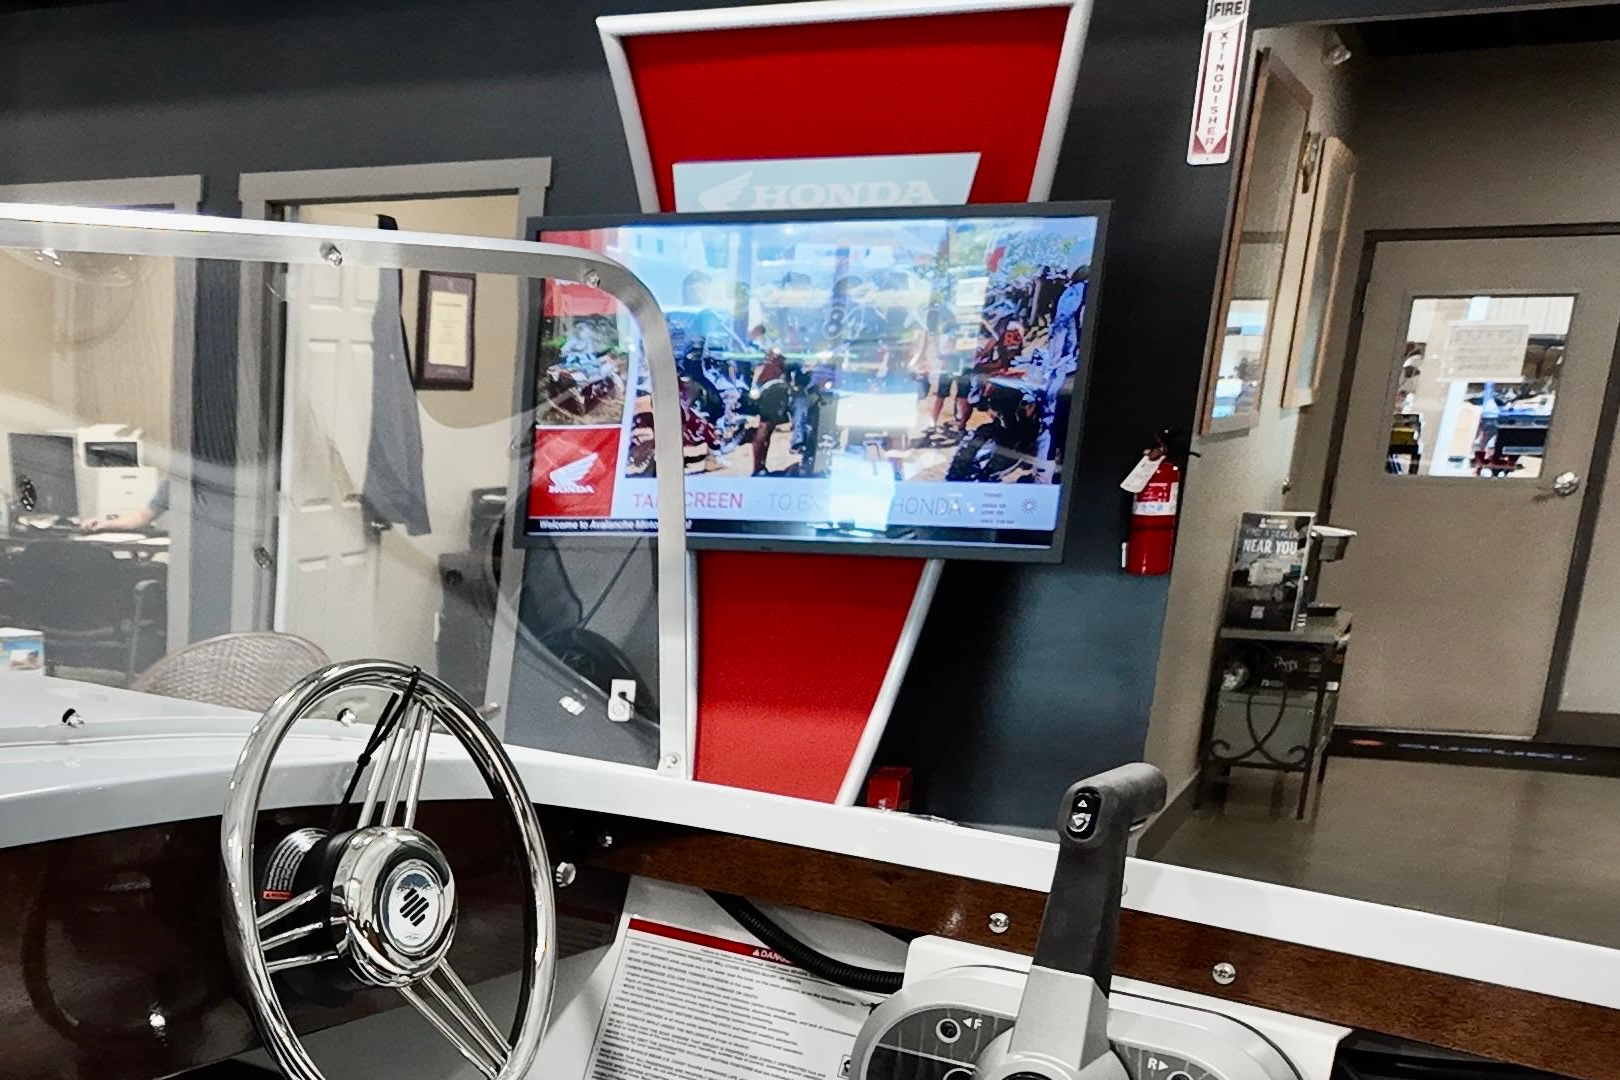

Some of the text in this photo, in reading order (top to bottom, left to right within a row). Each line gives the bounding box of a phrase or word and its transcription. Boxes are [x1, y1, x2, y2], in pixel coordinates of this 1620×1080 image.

[1213, 1, 1243, 16] FIRE
[1204, 31, 1229, 146] XTINGUISHER
[749, 180, 941, 209] HONDA
[633, 494, 658, 509] TA
[684, 492, 744, 509] CREEN
[769, 494, 794, 512] TO
[892, 496, 963, 516] HONDA
[539, 519, 577, 530] Welcome
[590, 520, 635, 530] Avalanche
[1242, 539, 1299, 555] NEAR YOU
[973, 1018, 983, 1030] F
[1147, 1057, 1158, 1070] R
